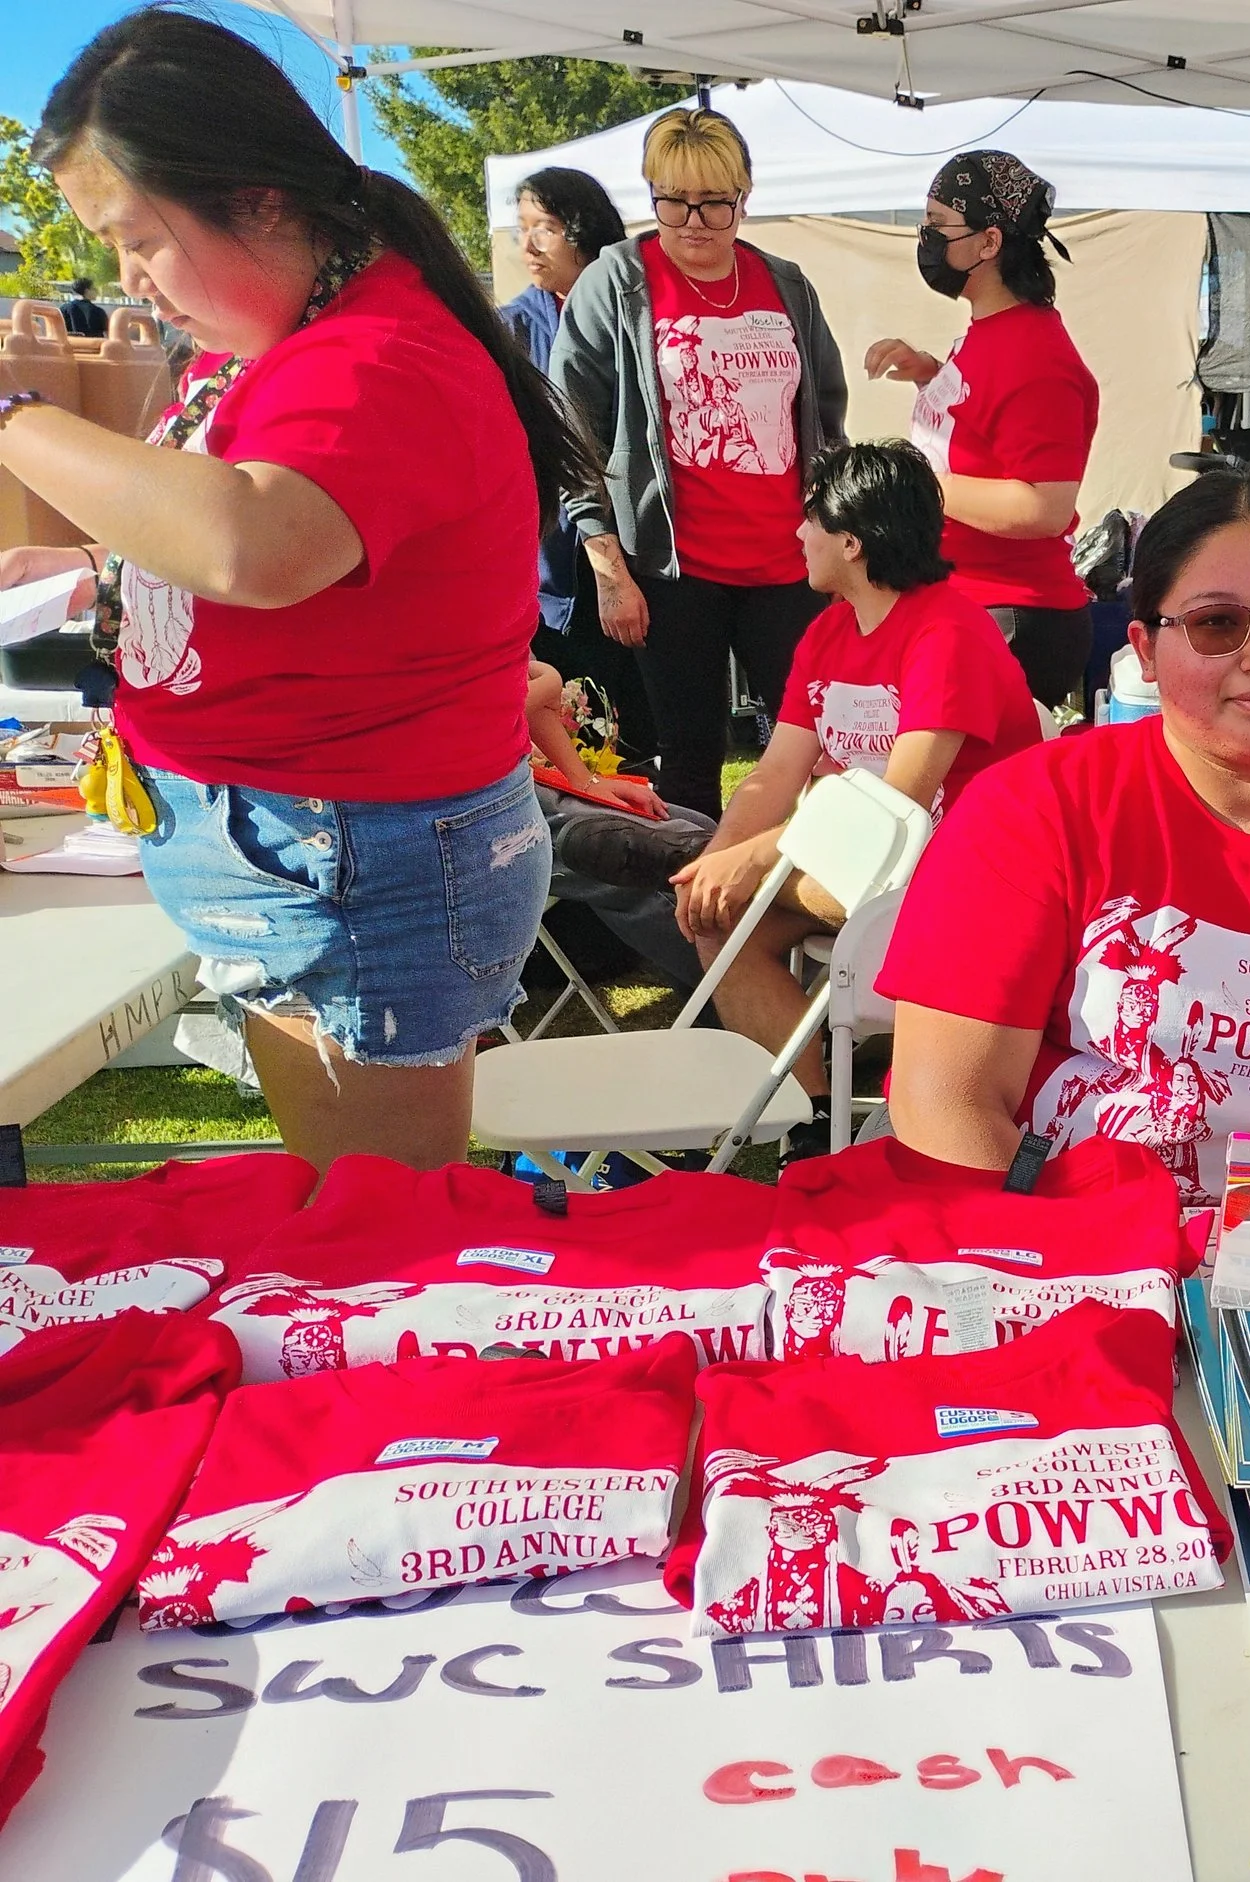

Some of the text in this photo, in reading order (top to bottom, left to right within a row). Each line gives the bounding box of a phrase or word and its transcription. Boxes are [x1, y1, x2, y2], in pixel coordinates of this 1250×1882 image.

[753, 340, 785, 350] ANNUAL
[721, 350, 798, 371] POW WOW
[522, 1253, 547, 1266] XL
[494, 1304, 697, 1332] 3RD ANNUAL
[938, 1409, 999, 1418] CUSTOM
[940, 1415, 989, 1426] LOGOS
[462, 1441, 484, 1449] M
[1031, 1452, 1161, 1474] COLLEGE
[395, 1474, 671, 1504] SOUTHWESTERN
[991, 1468, 1187, 1498] 3RD ANNUA
[455, 1494, 605, 1530] COLLEGE
[931, 1488, 1209, 1554] POW WO
[401, 1545, 486, 1584] 3RD
[493, 1530, 647, 1570] ANNUAL
[998, 1547, 1129, 1579] FEBRUARY
[1045, 1574, 1107, 1601] CHULA
[604, 1615, 1134, 1694] SHIRTS
[702, 1747, 1076, 1805] cash
